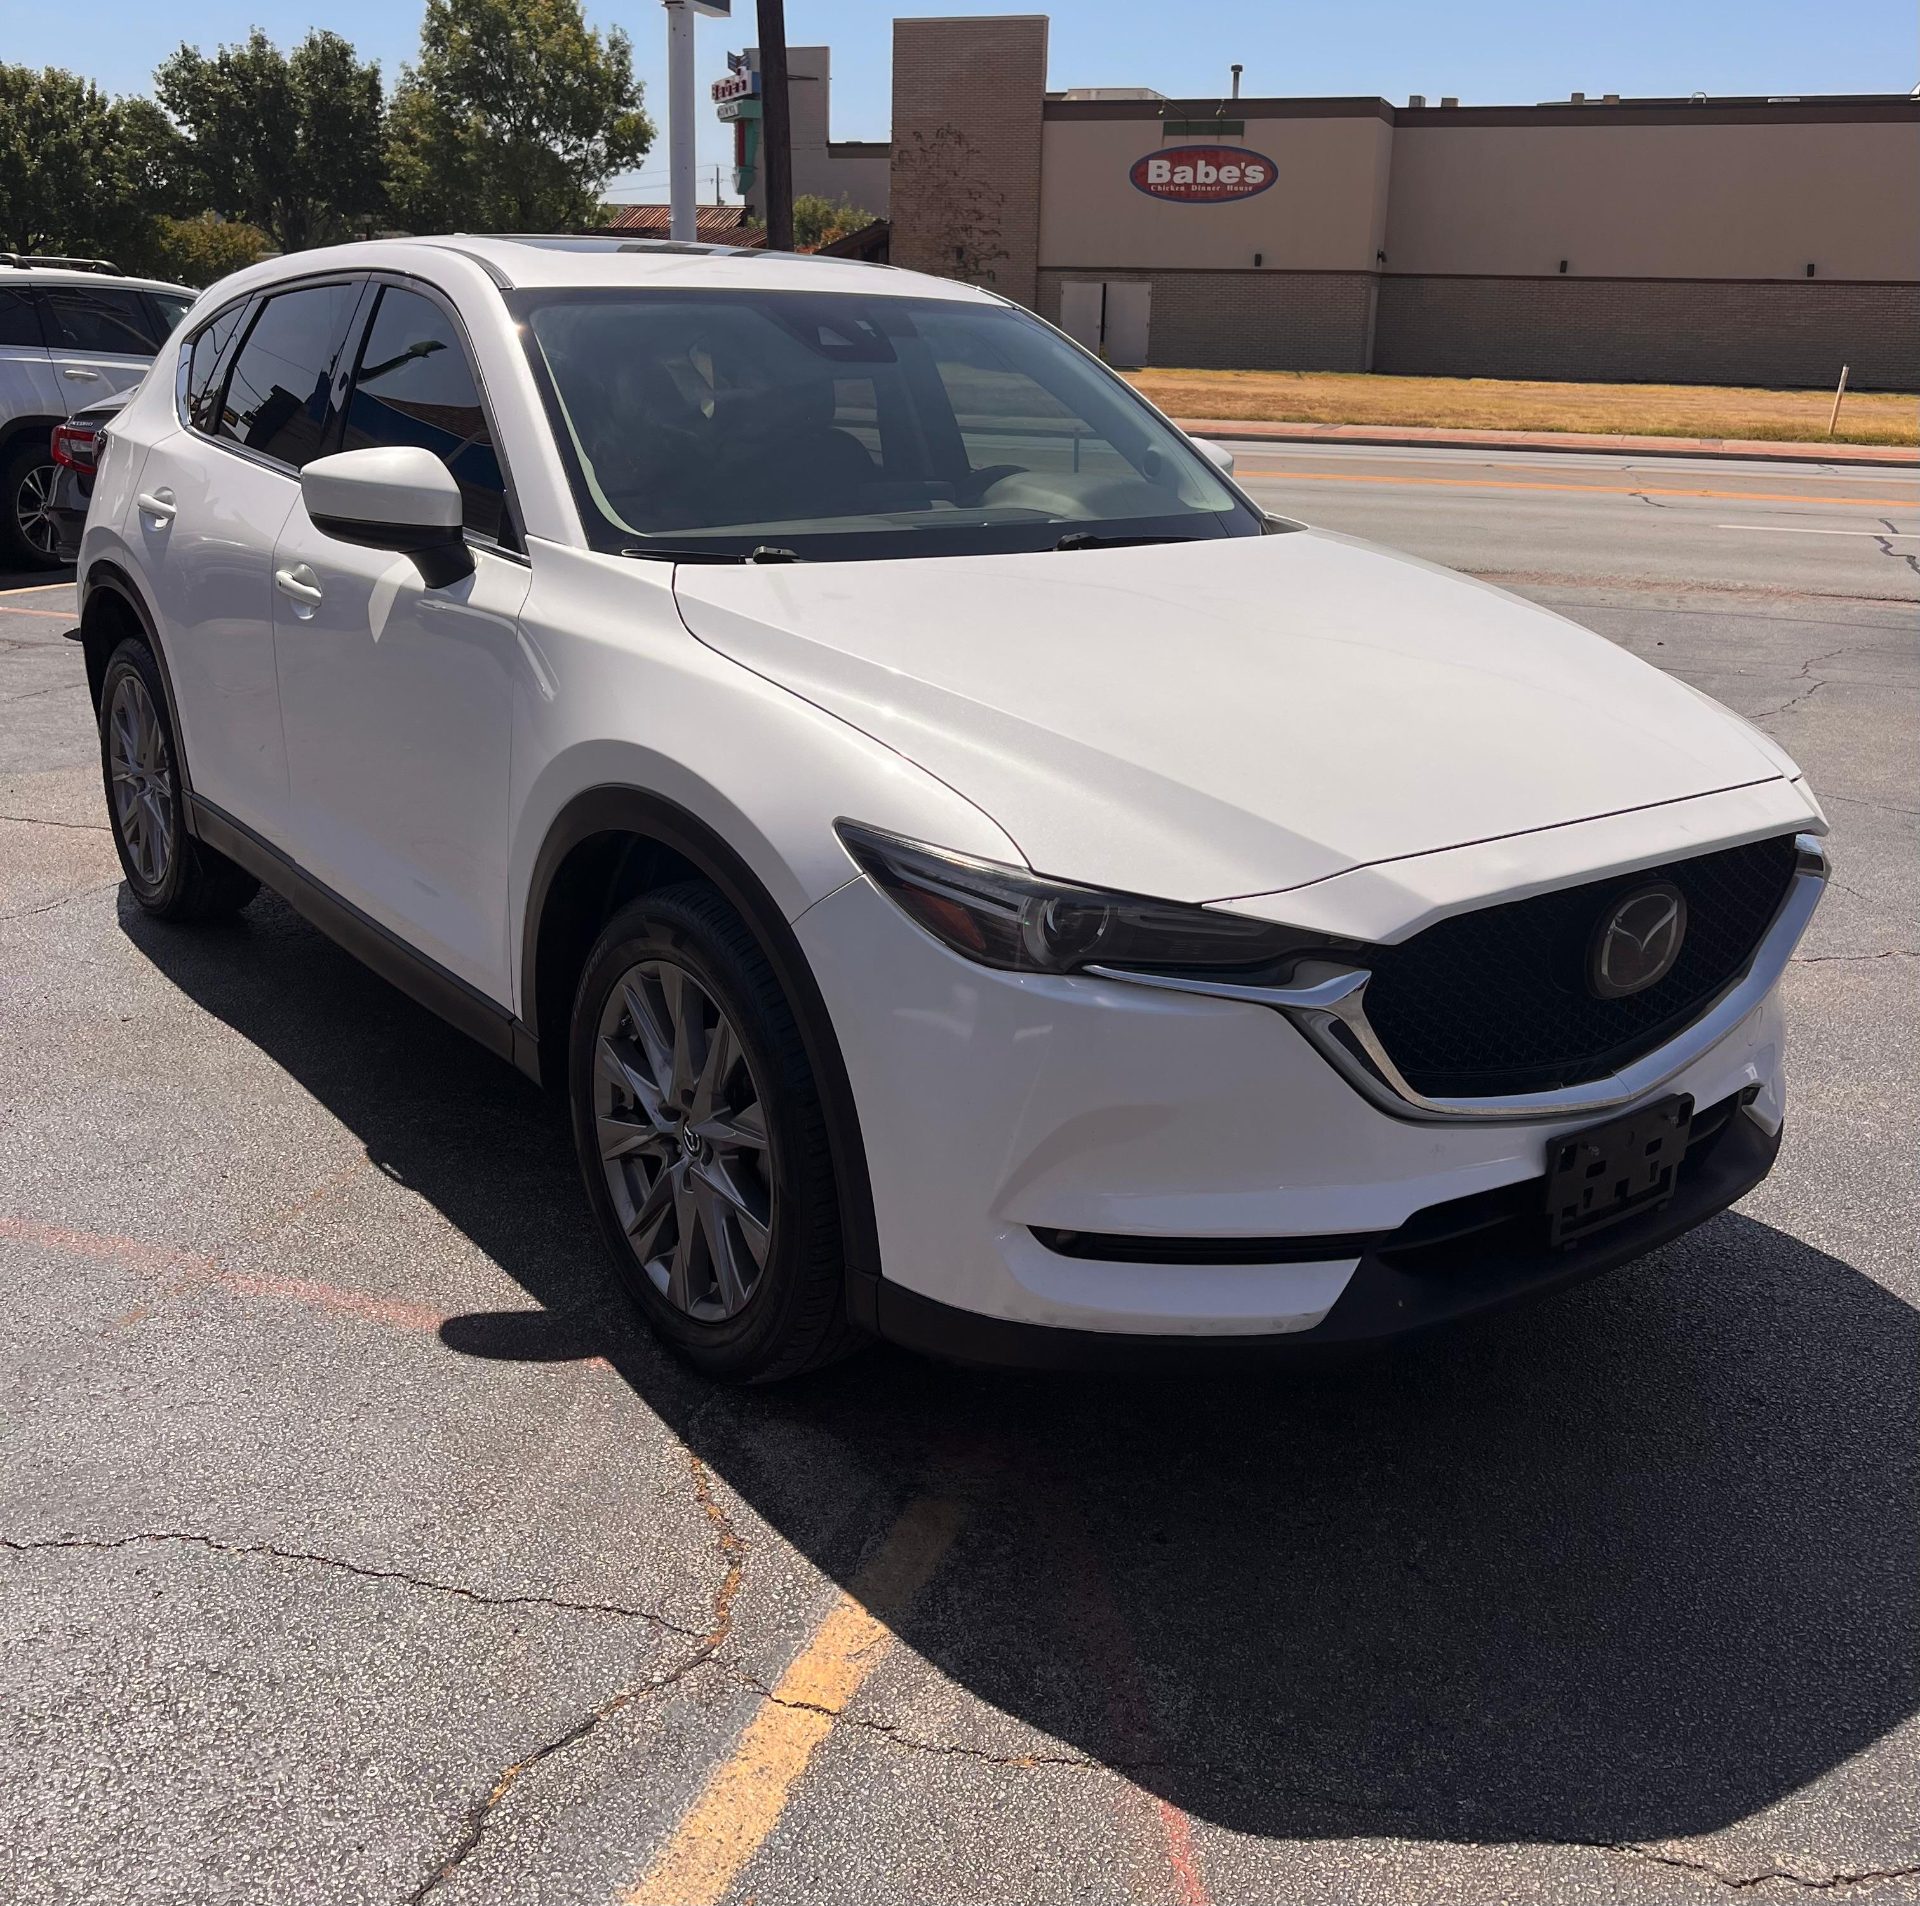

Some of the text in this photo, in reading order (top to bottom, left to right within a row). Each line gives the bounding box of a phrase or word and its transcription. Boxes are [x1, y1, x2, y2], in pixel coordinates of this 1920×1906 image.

[1147, 159, 1265, 184] Babe's
[1150, 184, 1253, 192] Chicken Dinner House
